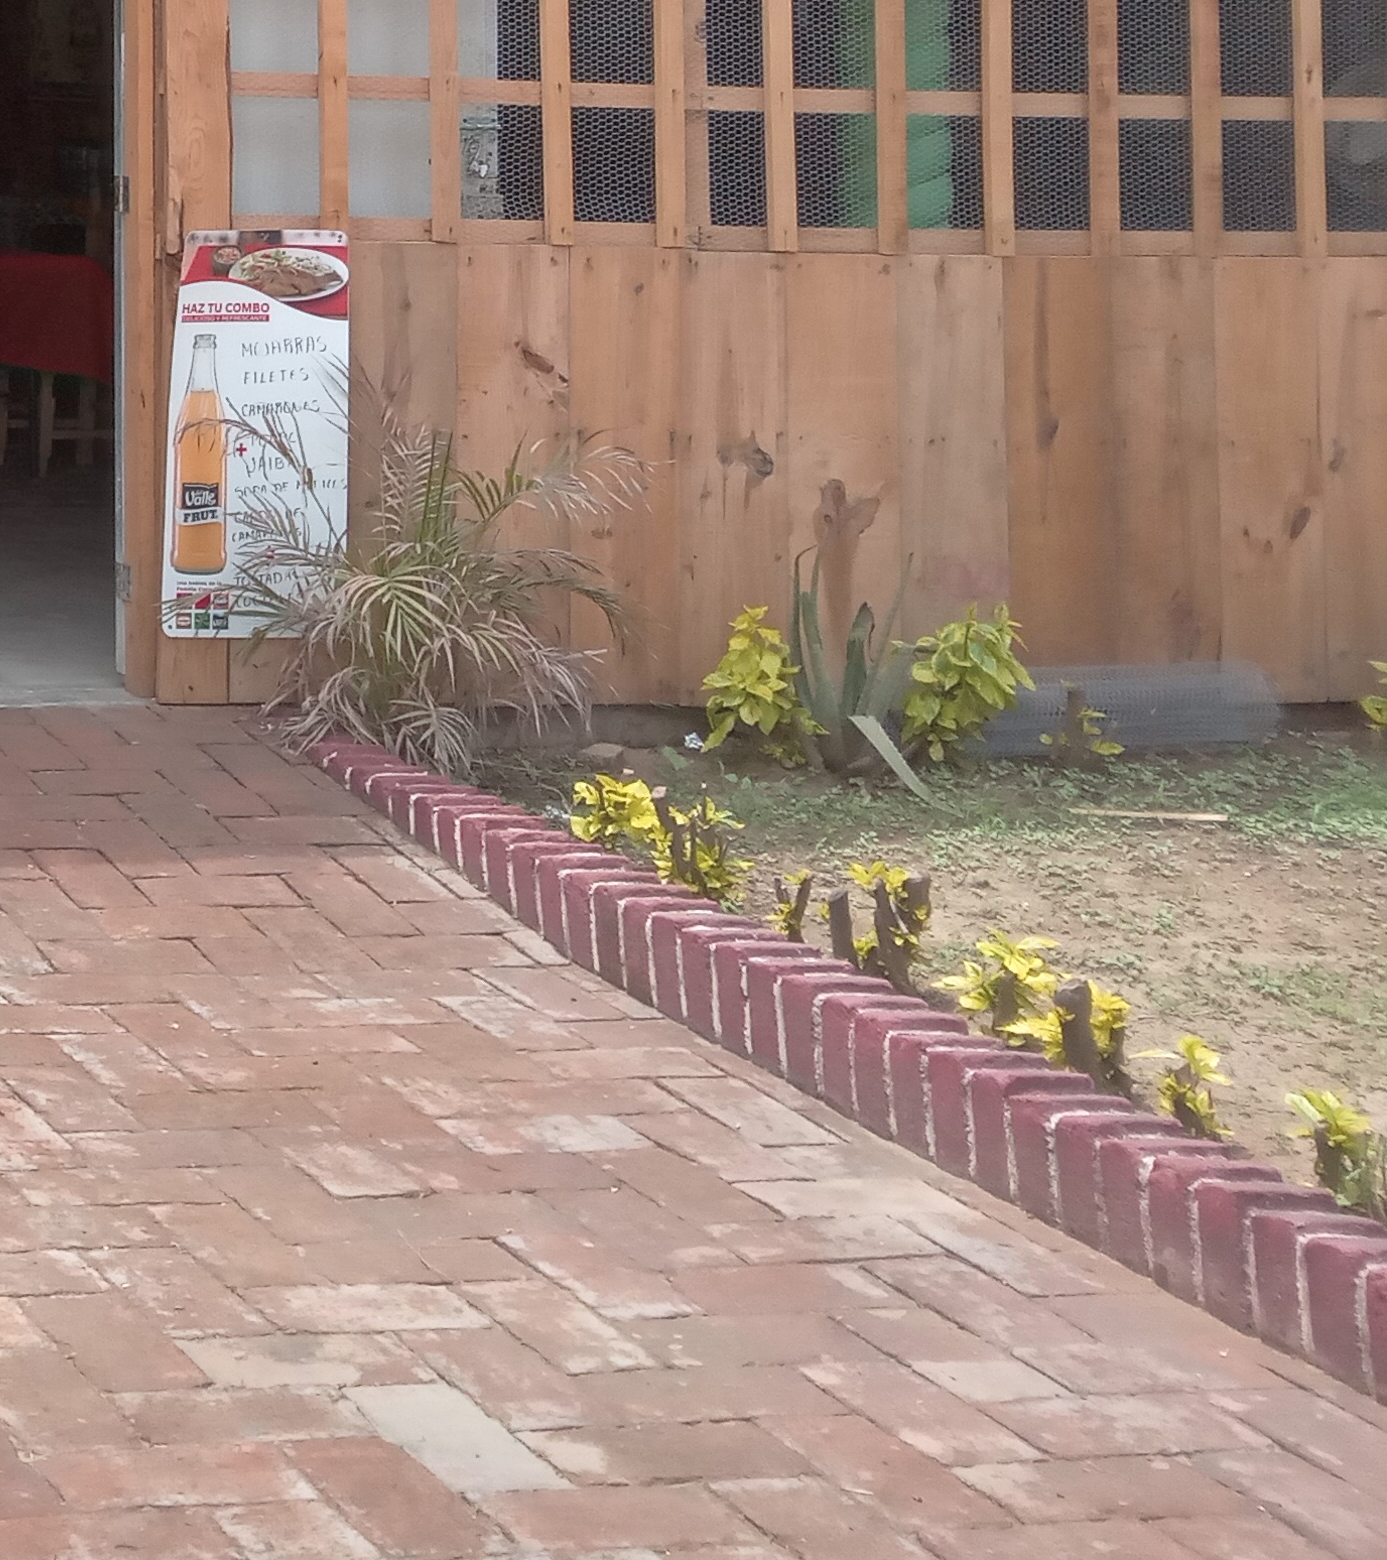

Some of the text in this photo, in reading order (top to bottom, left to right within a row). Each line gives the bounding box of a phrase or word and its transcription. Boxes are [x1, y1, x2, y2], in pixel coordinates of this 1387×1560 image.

[181, 302, 270, 314] HAZ TU COMBO
[242, 366, 310, 385] FILETES
